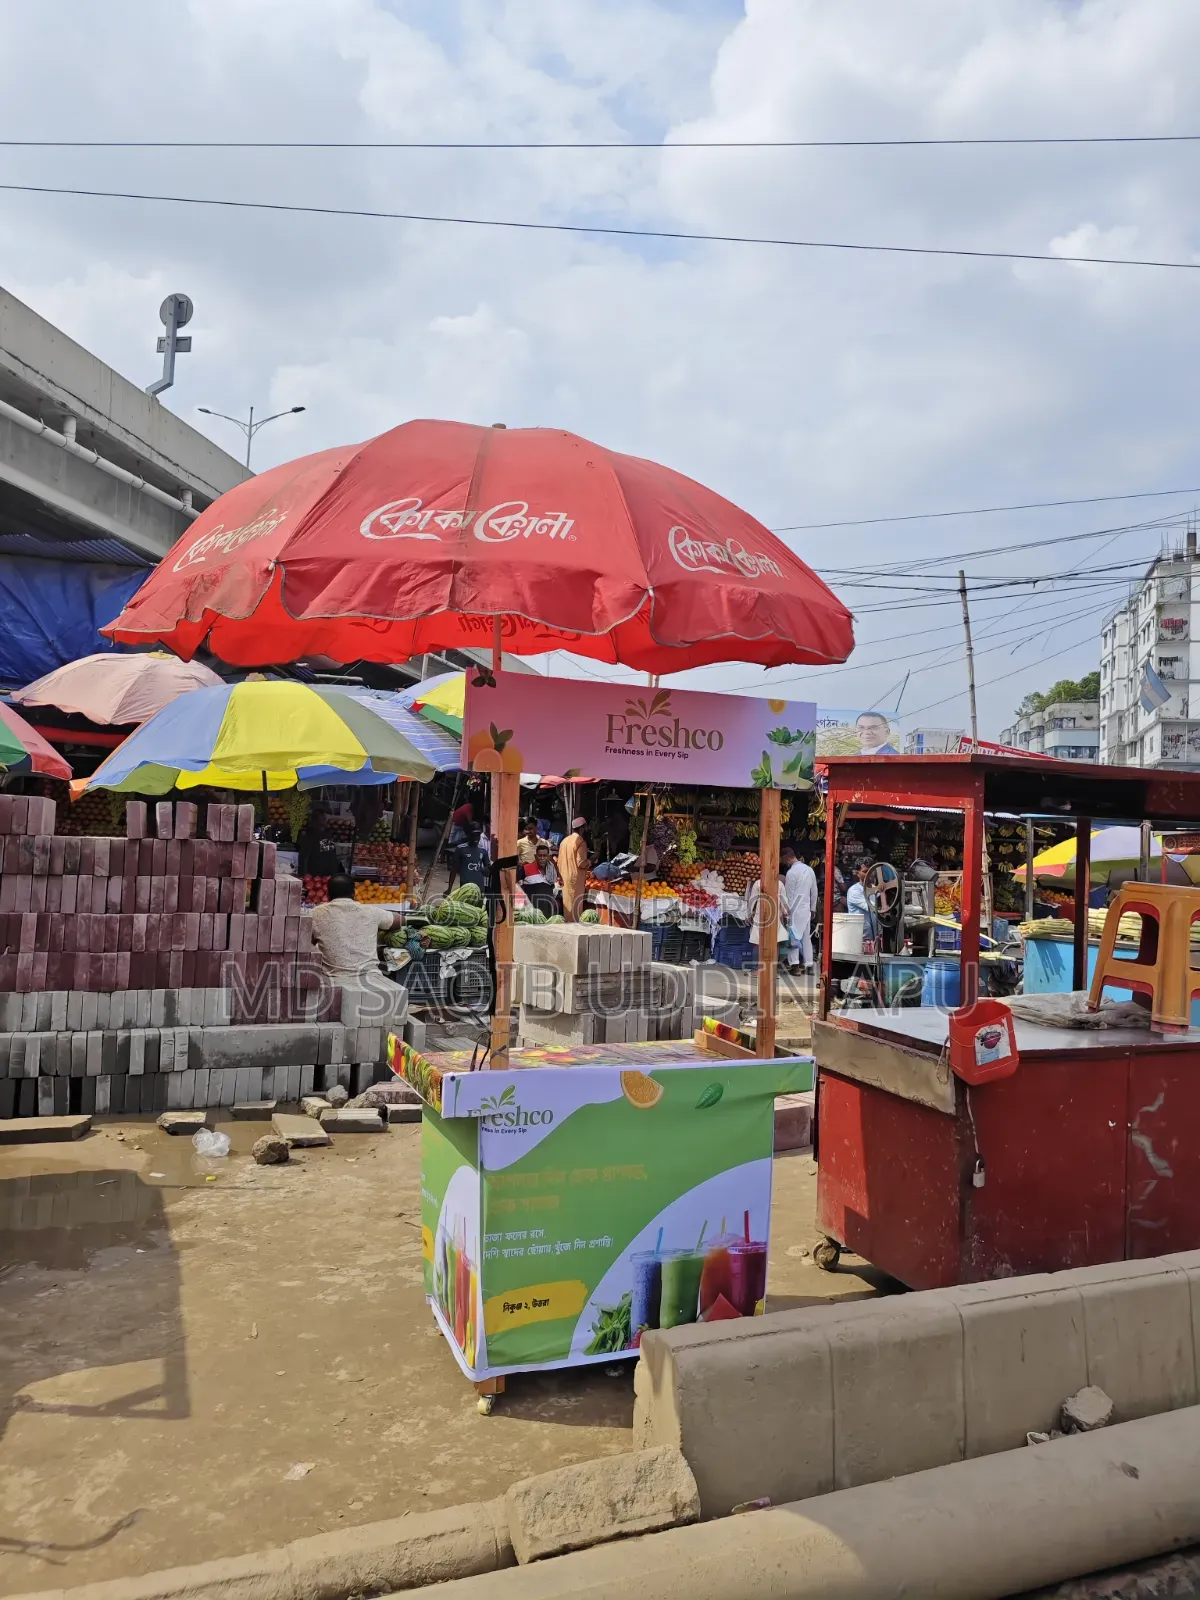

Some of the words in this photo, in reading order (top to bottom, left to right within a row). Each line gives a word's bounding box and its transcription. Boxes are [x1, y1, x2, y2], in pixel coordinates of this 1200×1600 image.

[606, 713, 724, 751] Freshco
[605, 746, 644, 756] Freshness
[646, 748, 653, 756] in
[655, 749, 675, 760] Every
[678, 750, 689, 760] Sip
